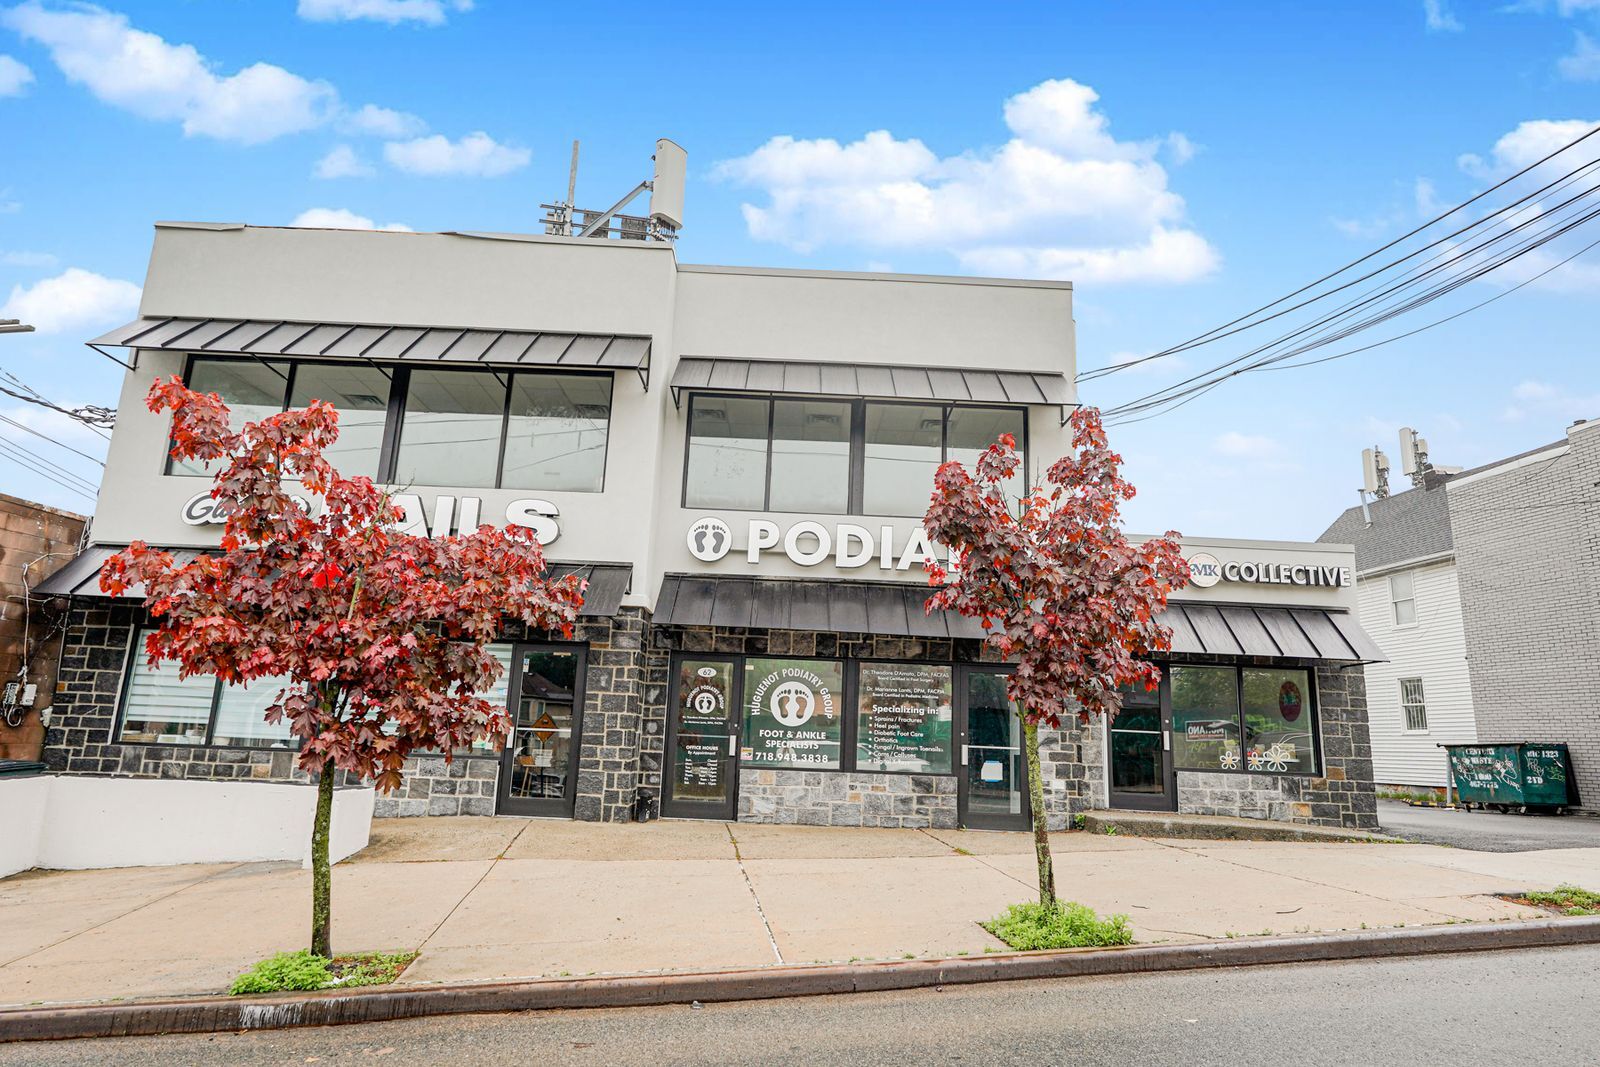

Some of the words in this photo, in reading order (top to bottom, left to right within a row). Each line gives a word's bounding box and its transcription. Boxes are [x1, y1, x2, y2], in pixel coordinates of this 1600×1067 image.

[318, 485, 560, 547] AILS
[747, 519, 961, 573] PODIA
[1190, 562, 1219, 577] MK
[1223, 561, 1351, 588] COLLECTIVE
[751, 671, 780, 716] HUGUENOT
[782, 668, 824, 688] PODIATRY
[820, 687, 833, 720] GROUP
[872, 704, 925, 716] Specializing
[927, 706, 939, 715] in:
[759, 729, 784, 738] FOOT
[796, 731, 827, 740] ANKLE
[765, 739, 819, 750] SPECIALISTS
[755, 751, 828, 763] 718.948.3838
